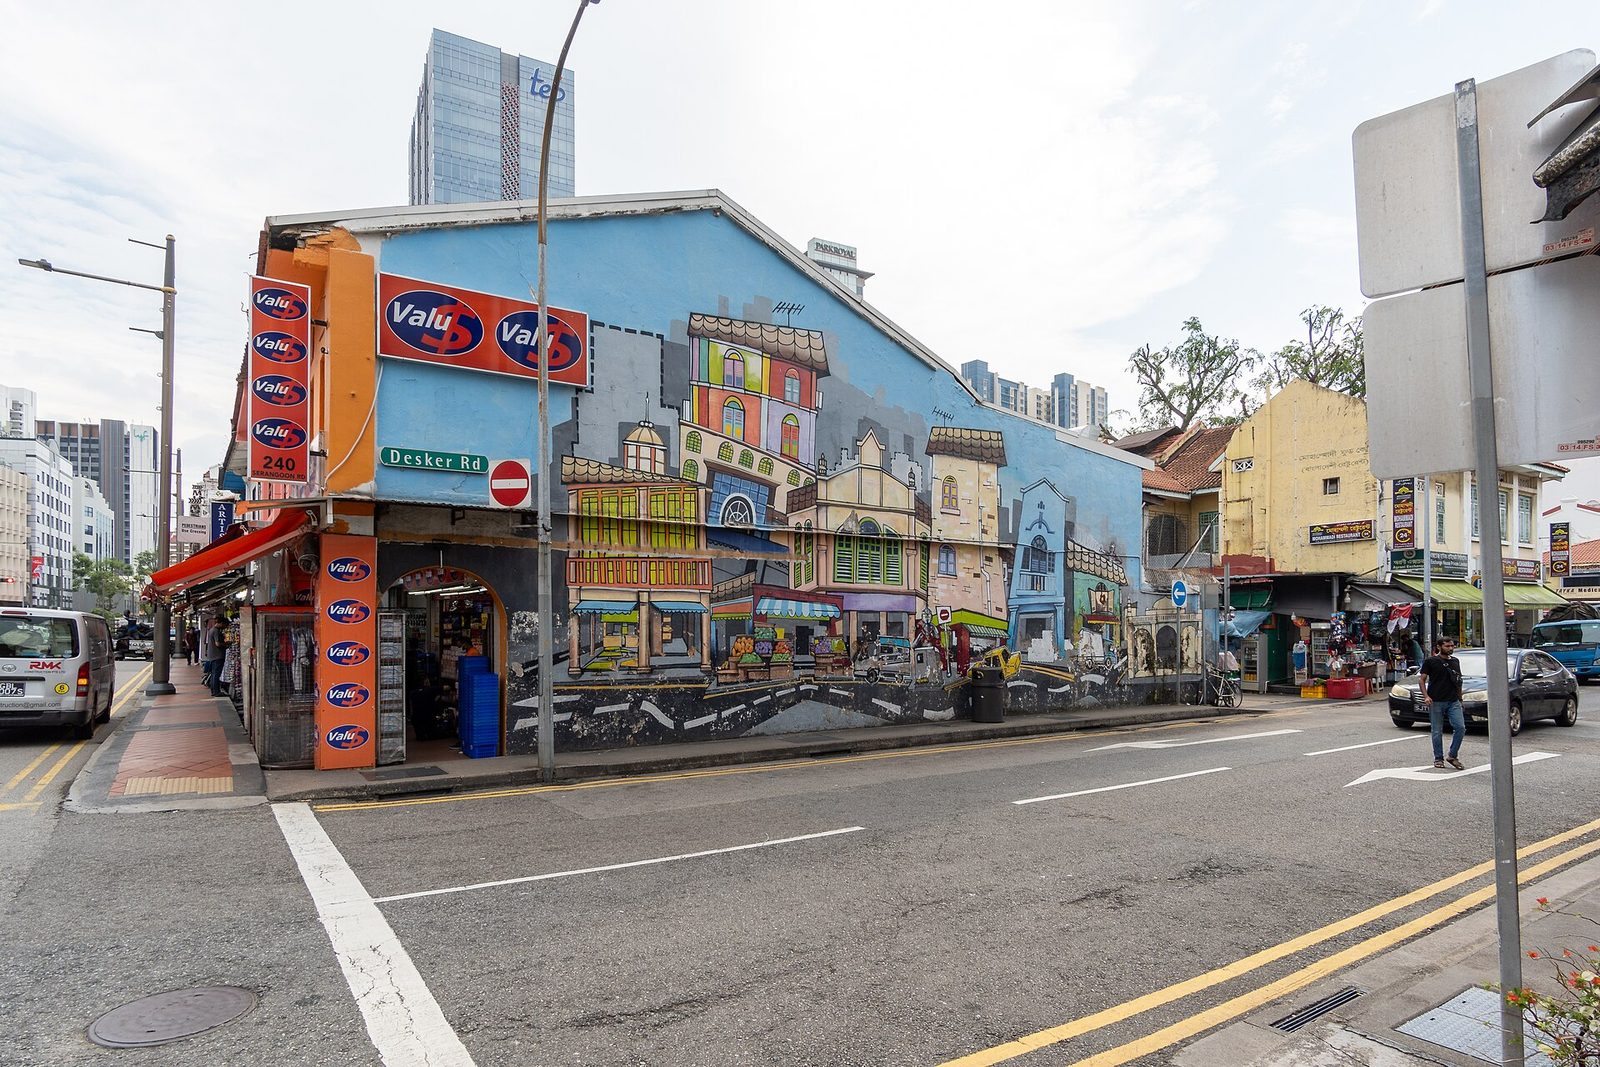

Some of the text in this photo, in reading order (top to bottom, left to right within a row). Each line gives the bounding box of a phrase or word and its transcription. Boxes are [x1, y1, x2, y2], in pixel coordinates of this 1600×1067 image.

[815, 241, 856, 258] PARKROYAL
[263, 455, 296, 471] 240
[390, 449, 482, 471] Desker Rd
[252, 469, 295, 479] SERANGOON
[29, 661, 62, 670] RMK
